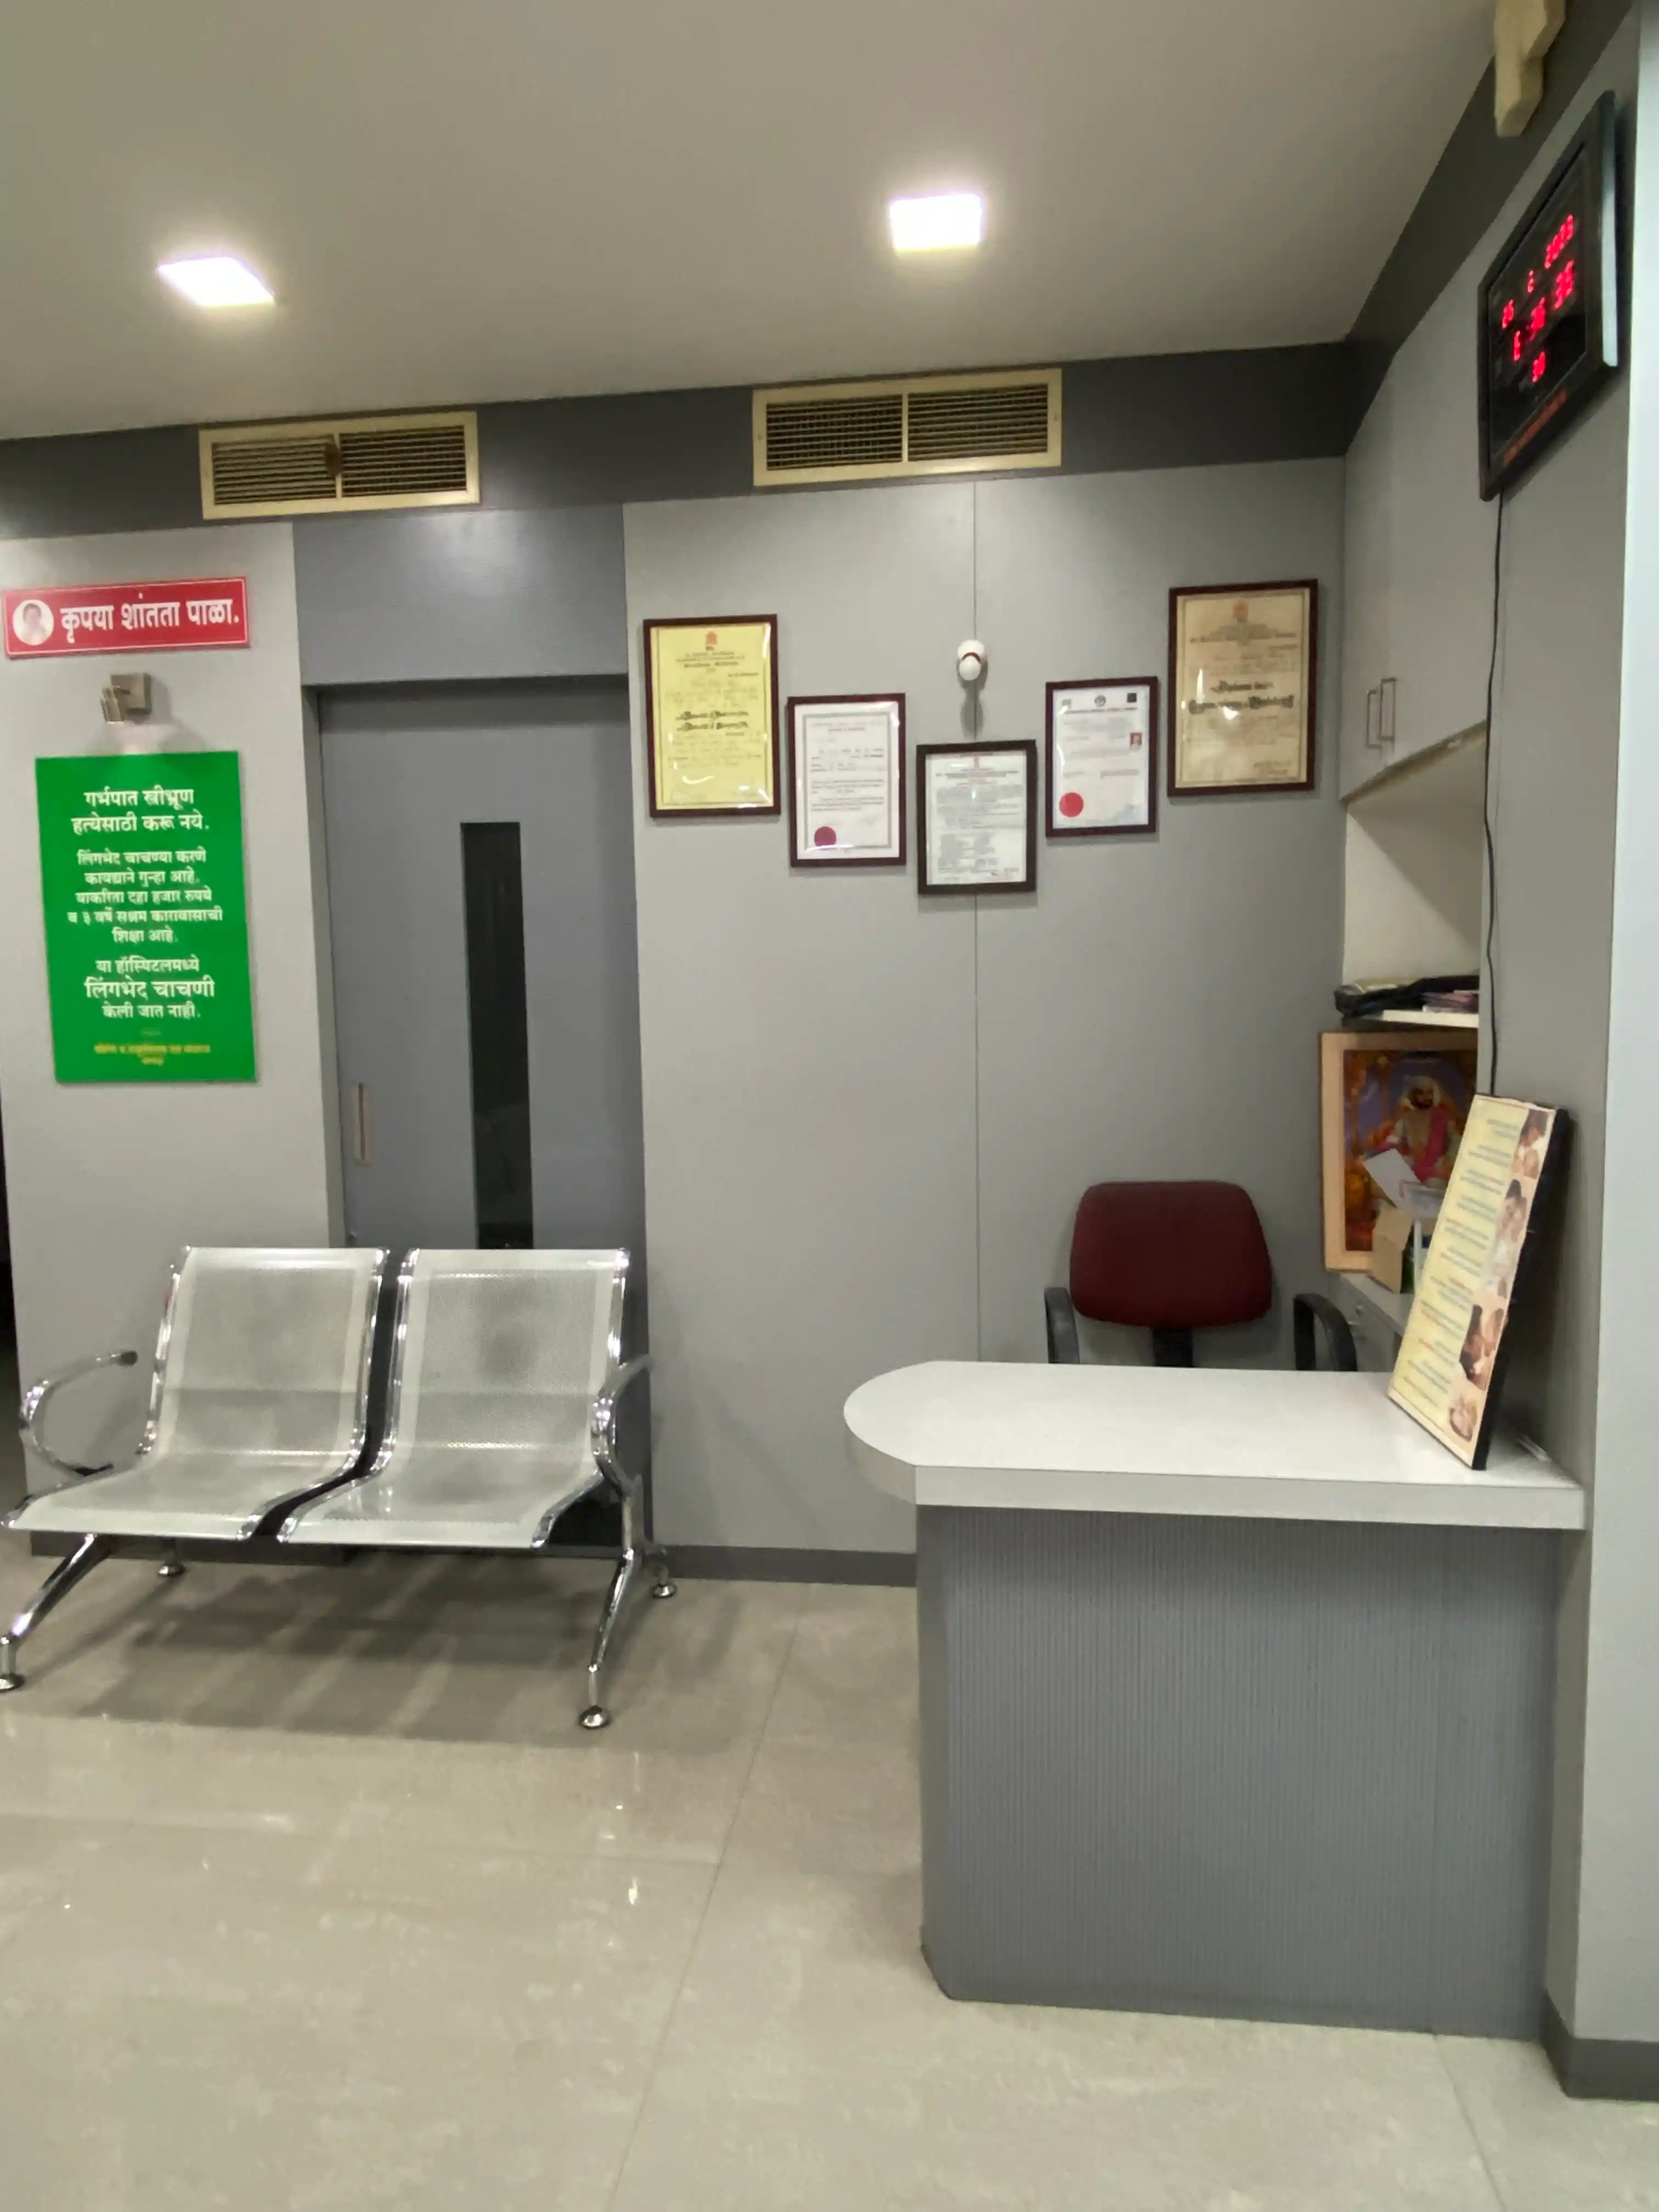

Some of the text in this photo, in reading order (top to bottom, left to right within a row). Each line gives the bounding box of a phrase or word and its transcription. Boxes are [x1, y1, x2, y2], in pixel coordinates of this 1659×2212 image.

[60, 592, 239, 643] कृपया शांतता पाळा.
[83, 786, 138, 807] गर्भपात
[70, 811, 137, 836] हत्येसाठी
[141, 815, 175, 831] करू
[176, 846, 206, 863] करणे
[138, 871, 166, 887] गुन्हा
[95, 960, 112, 973] या
[84, 974, 215, 1001] लिंगभेद चाचणी
[102, 1001, 133, 1018] केली
[137, 1005, 164, 1018] जात
